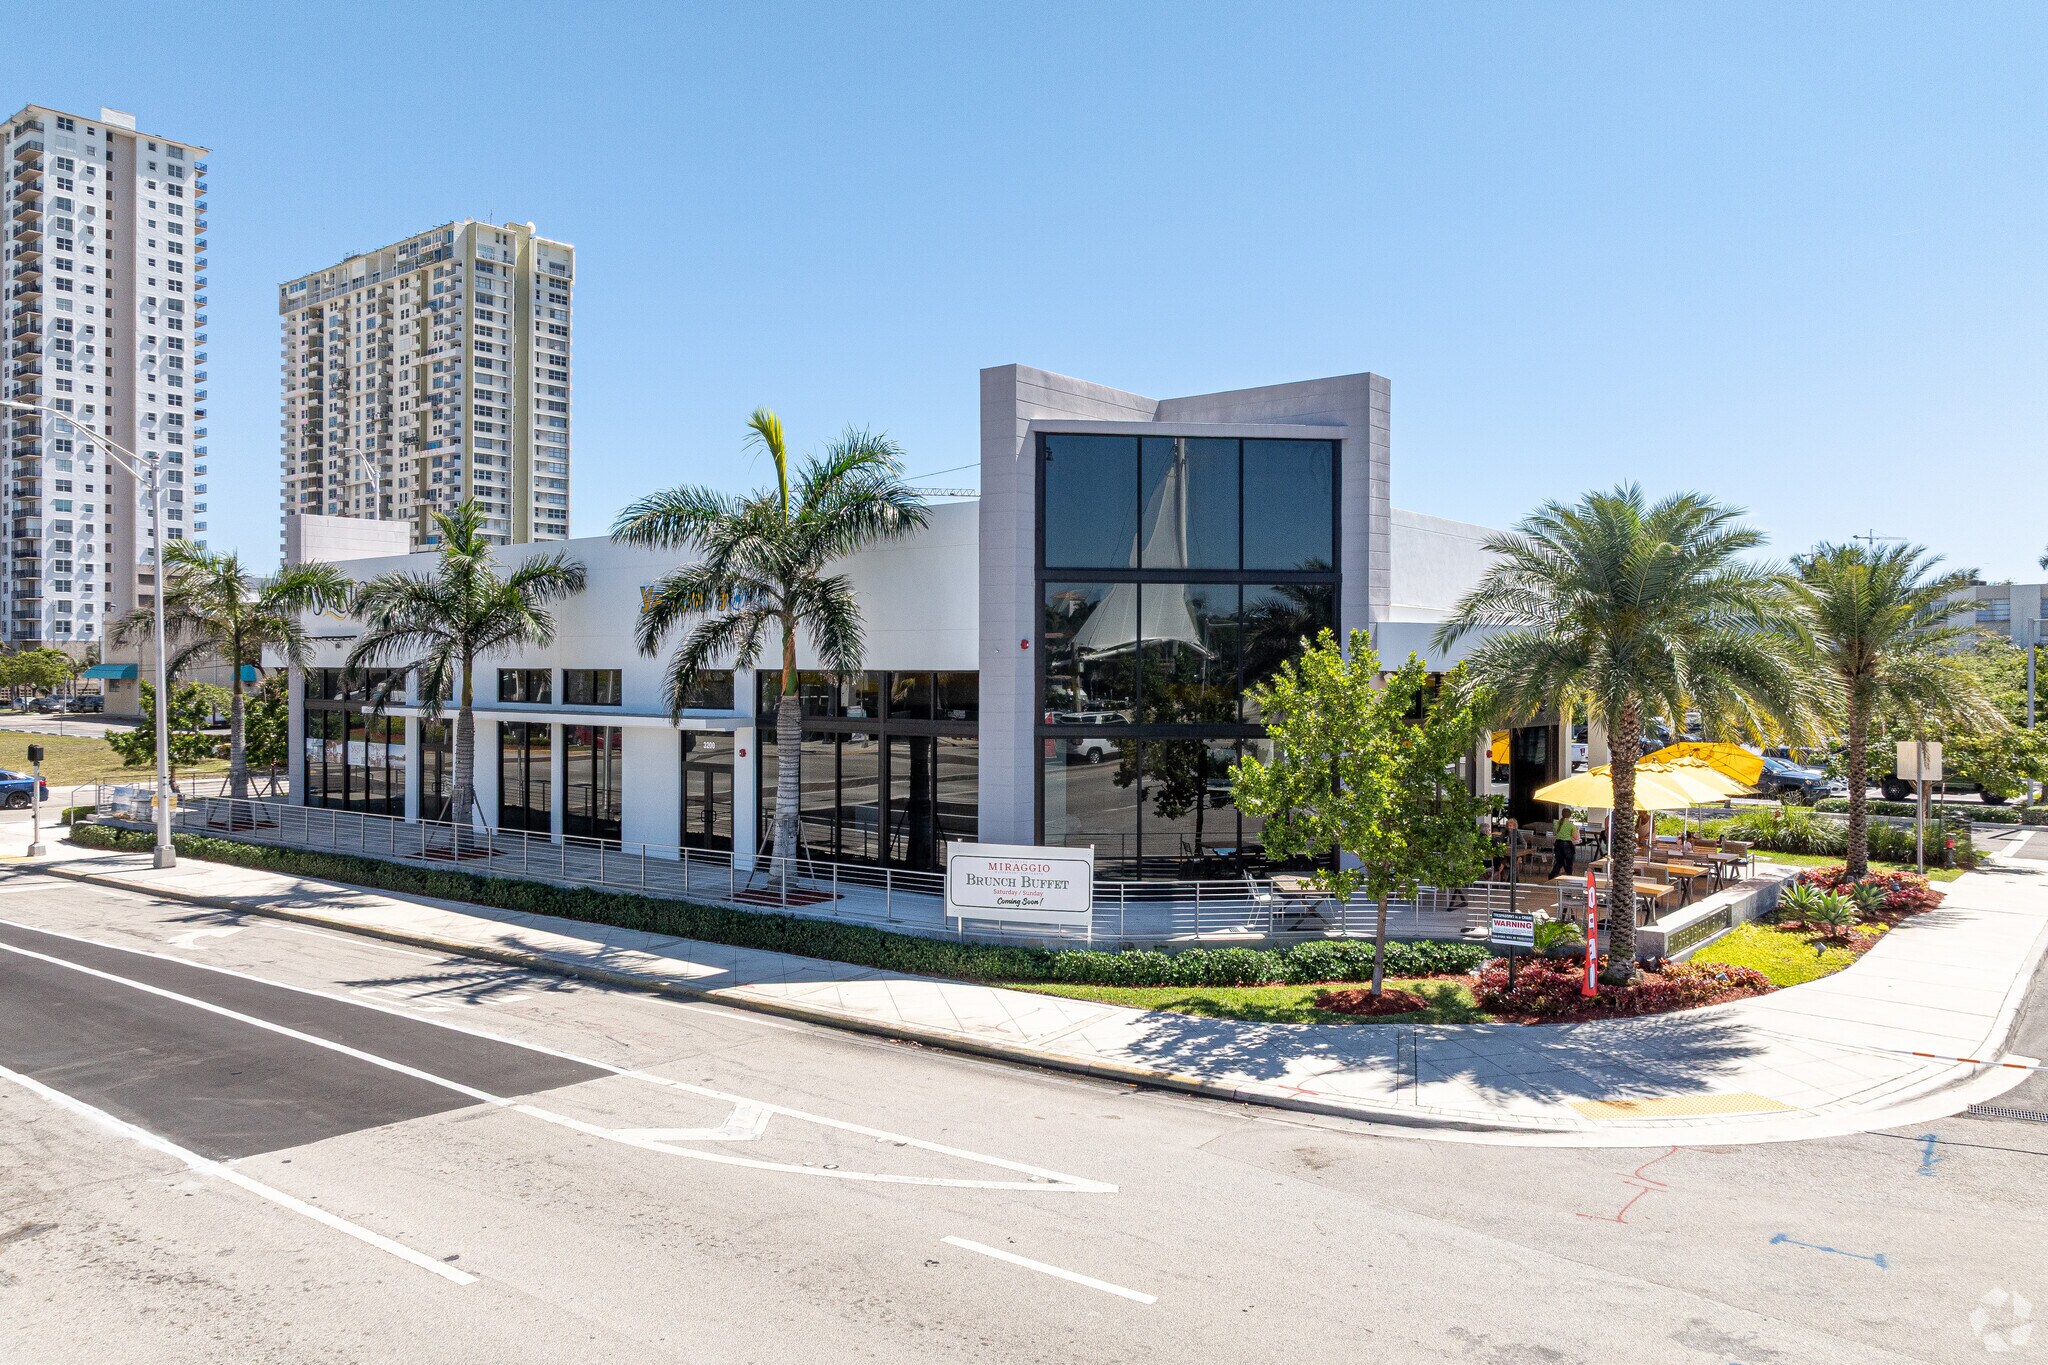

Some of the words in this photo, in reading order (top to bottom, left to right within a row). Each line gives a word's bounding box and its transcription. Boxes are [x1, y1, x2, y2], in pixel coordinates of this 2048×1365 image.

[988, 863, 1050, 873] MIRAGGIO
[966, 873, 1016, 887] BRUNCH
[1021, 876, 1069, 889] BUFFET
[997, 897, 1020, 907] Coming
[1494, 920, 1531, 929] WARNING
